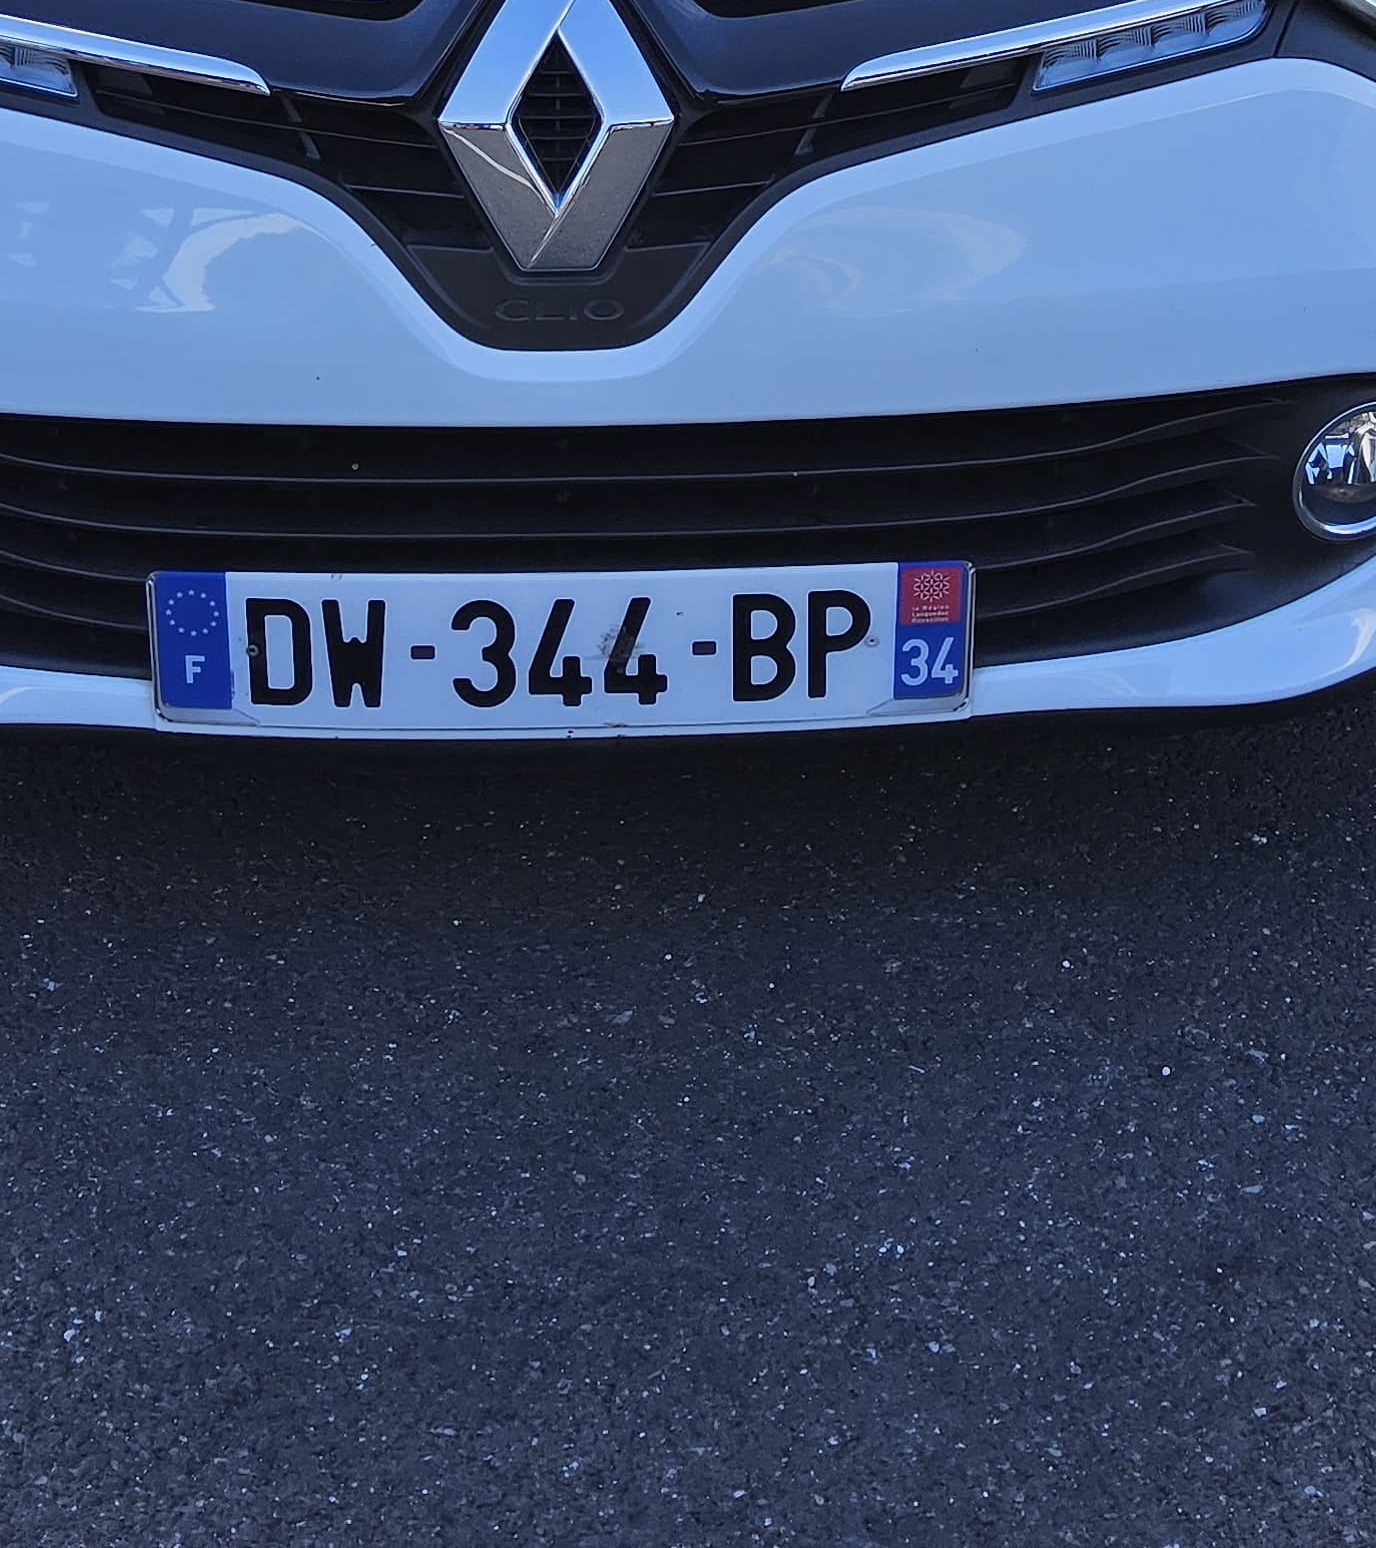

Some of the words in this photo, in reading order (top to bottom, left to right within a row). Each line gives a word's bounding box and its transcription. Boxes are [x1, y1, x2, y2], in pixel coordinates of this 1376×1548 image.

[494, 299, 624, 321] CLIO
[246, 590, 871, 708] DW-344-BP
[901, 637, 959, 686] 34
[185, 655, 205, 684] F
